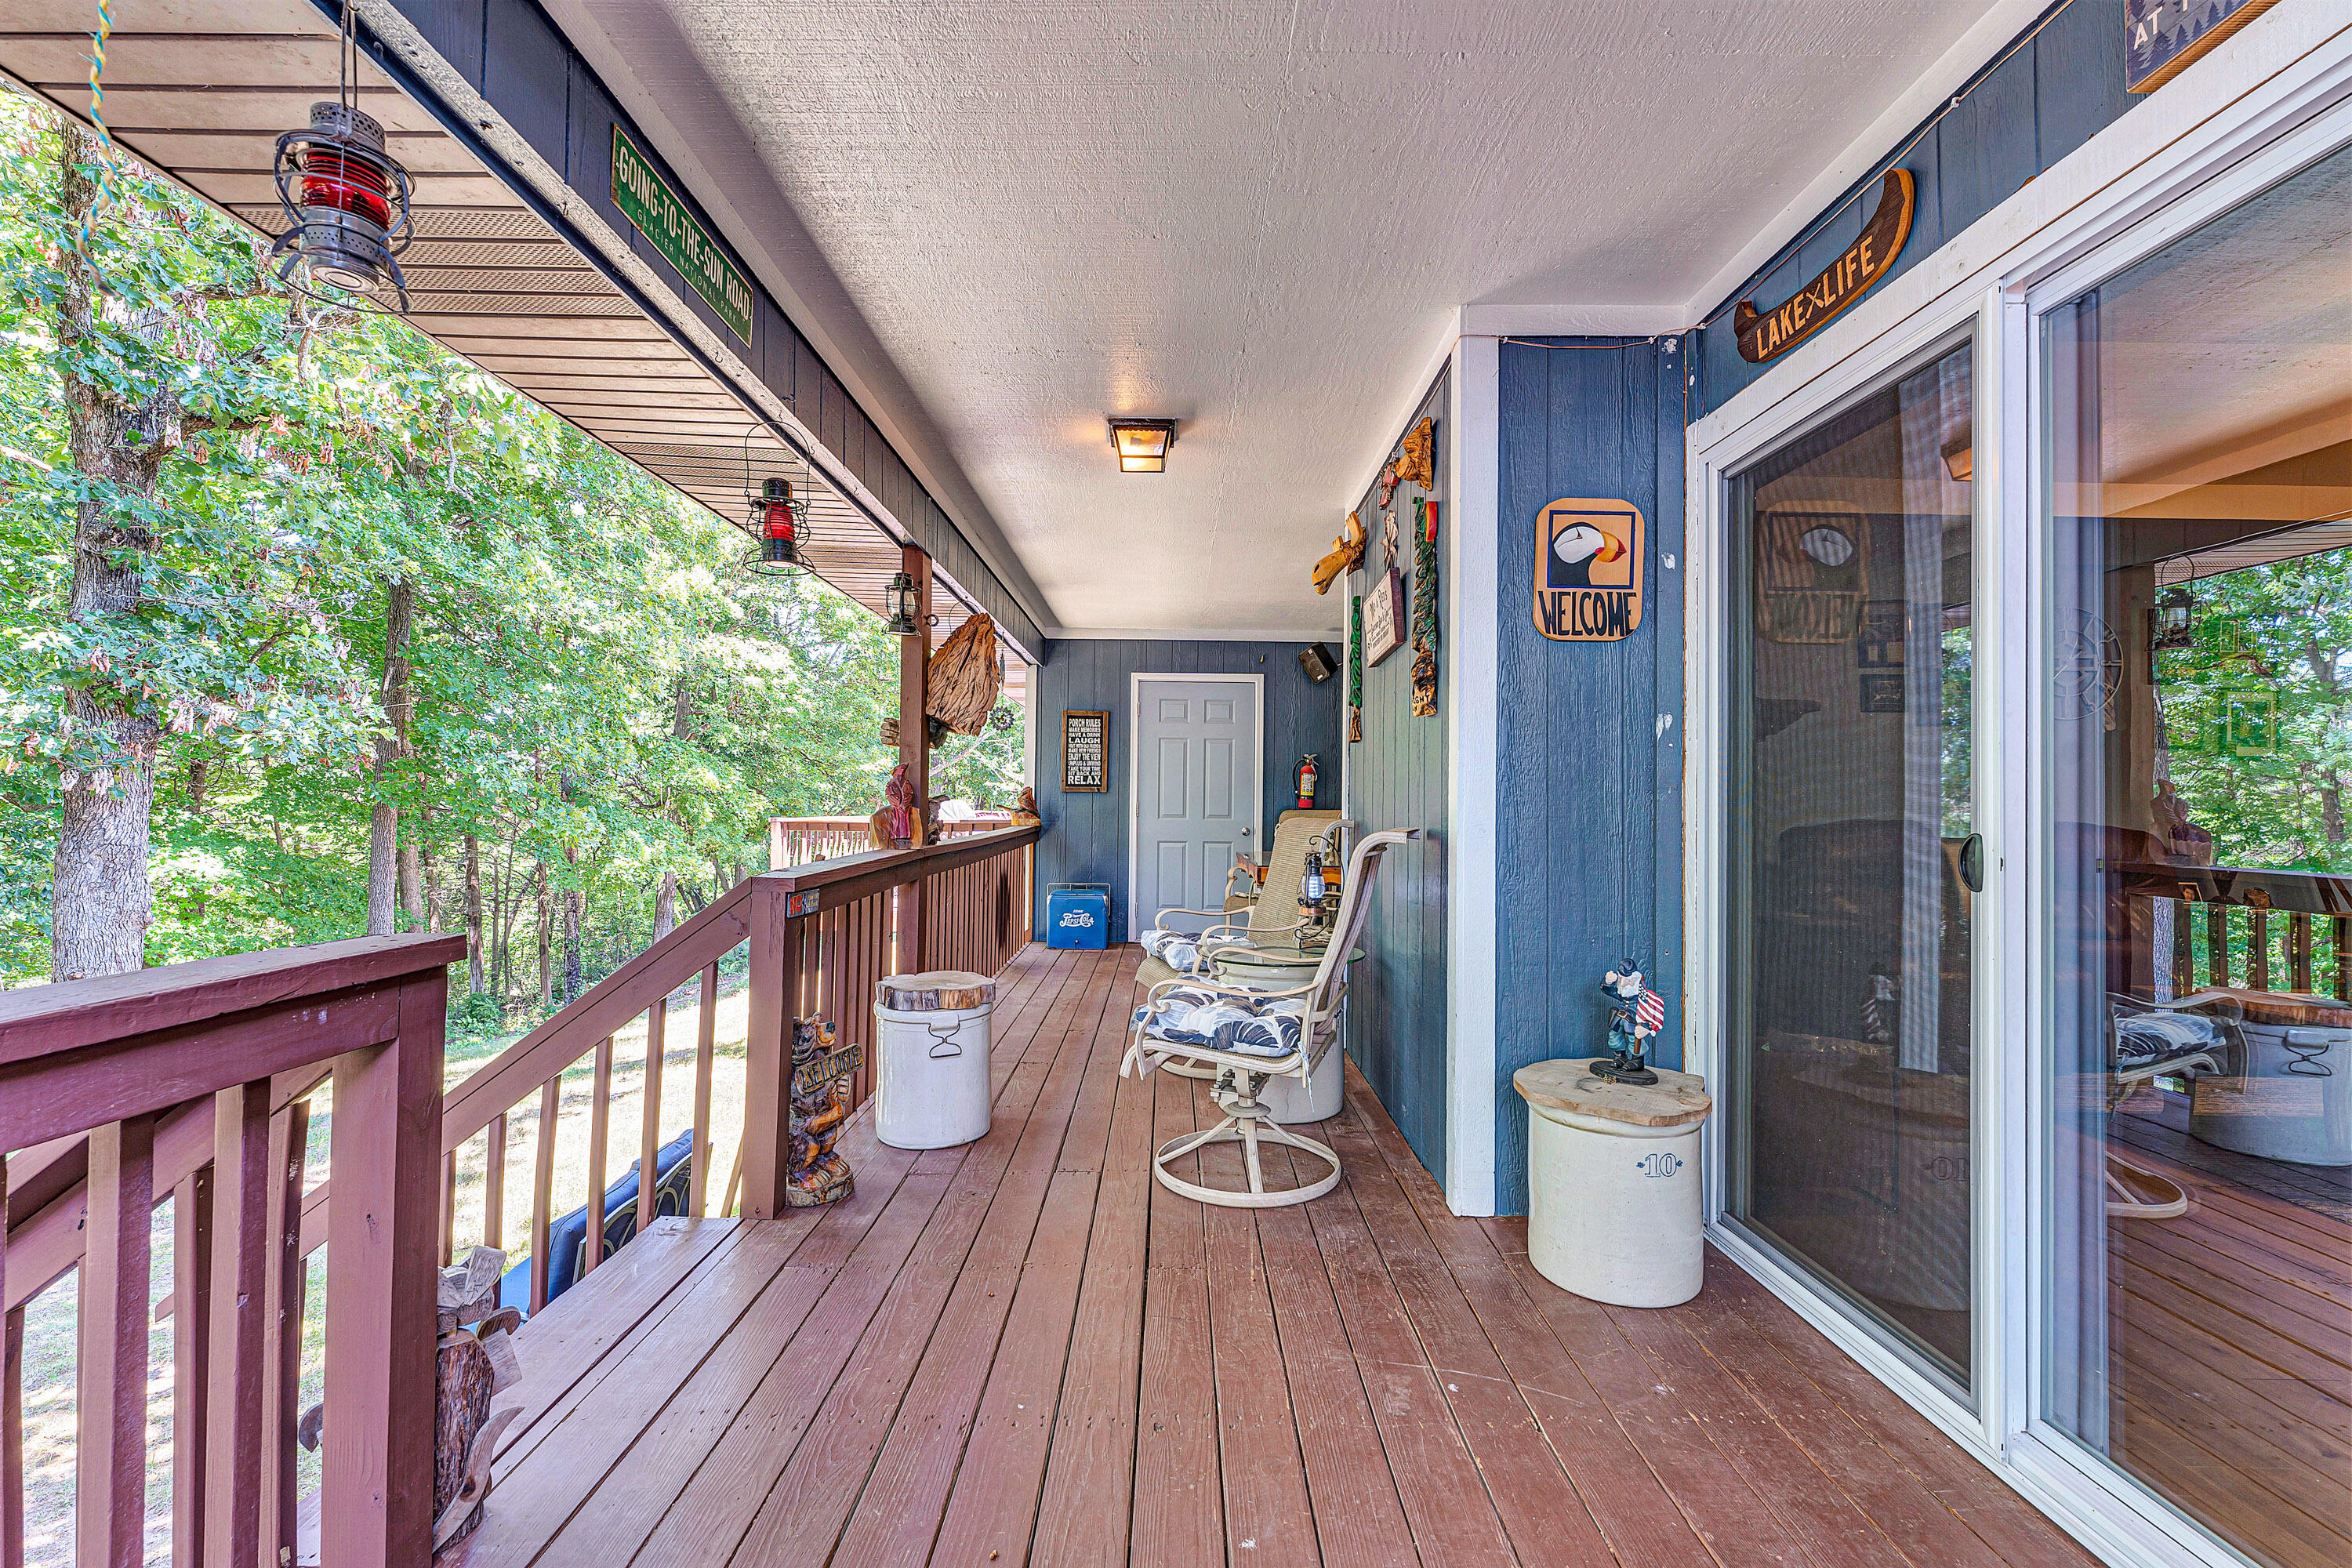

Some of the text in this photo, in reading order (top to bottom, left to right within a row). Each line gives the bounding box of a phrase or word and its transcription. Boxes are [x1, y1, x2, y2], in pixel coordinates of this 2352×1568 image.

[2133, 5, 2163, 51] AT
[619, 146, 750, 321] GOING-TO-THE-SUN ROAD
[637, 209, 738, 325] GLACIER NATIONAL PARK
[1756, 235, 1875, 359] LAKE LIFE
[1537, 590, 1637, 637] WELCOME
[1069, 718, 1101, 728] PORCH RULES
[1068, 775, 1101, 785] RELAX
[789, 894, 803, 915] NO
[799, 1046, 862, 1090] WELCOME
[1644, 1152, 1677, 1178] 10
